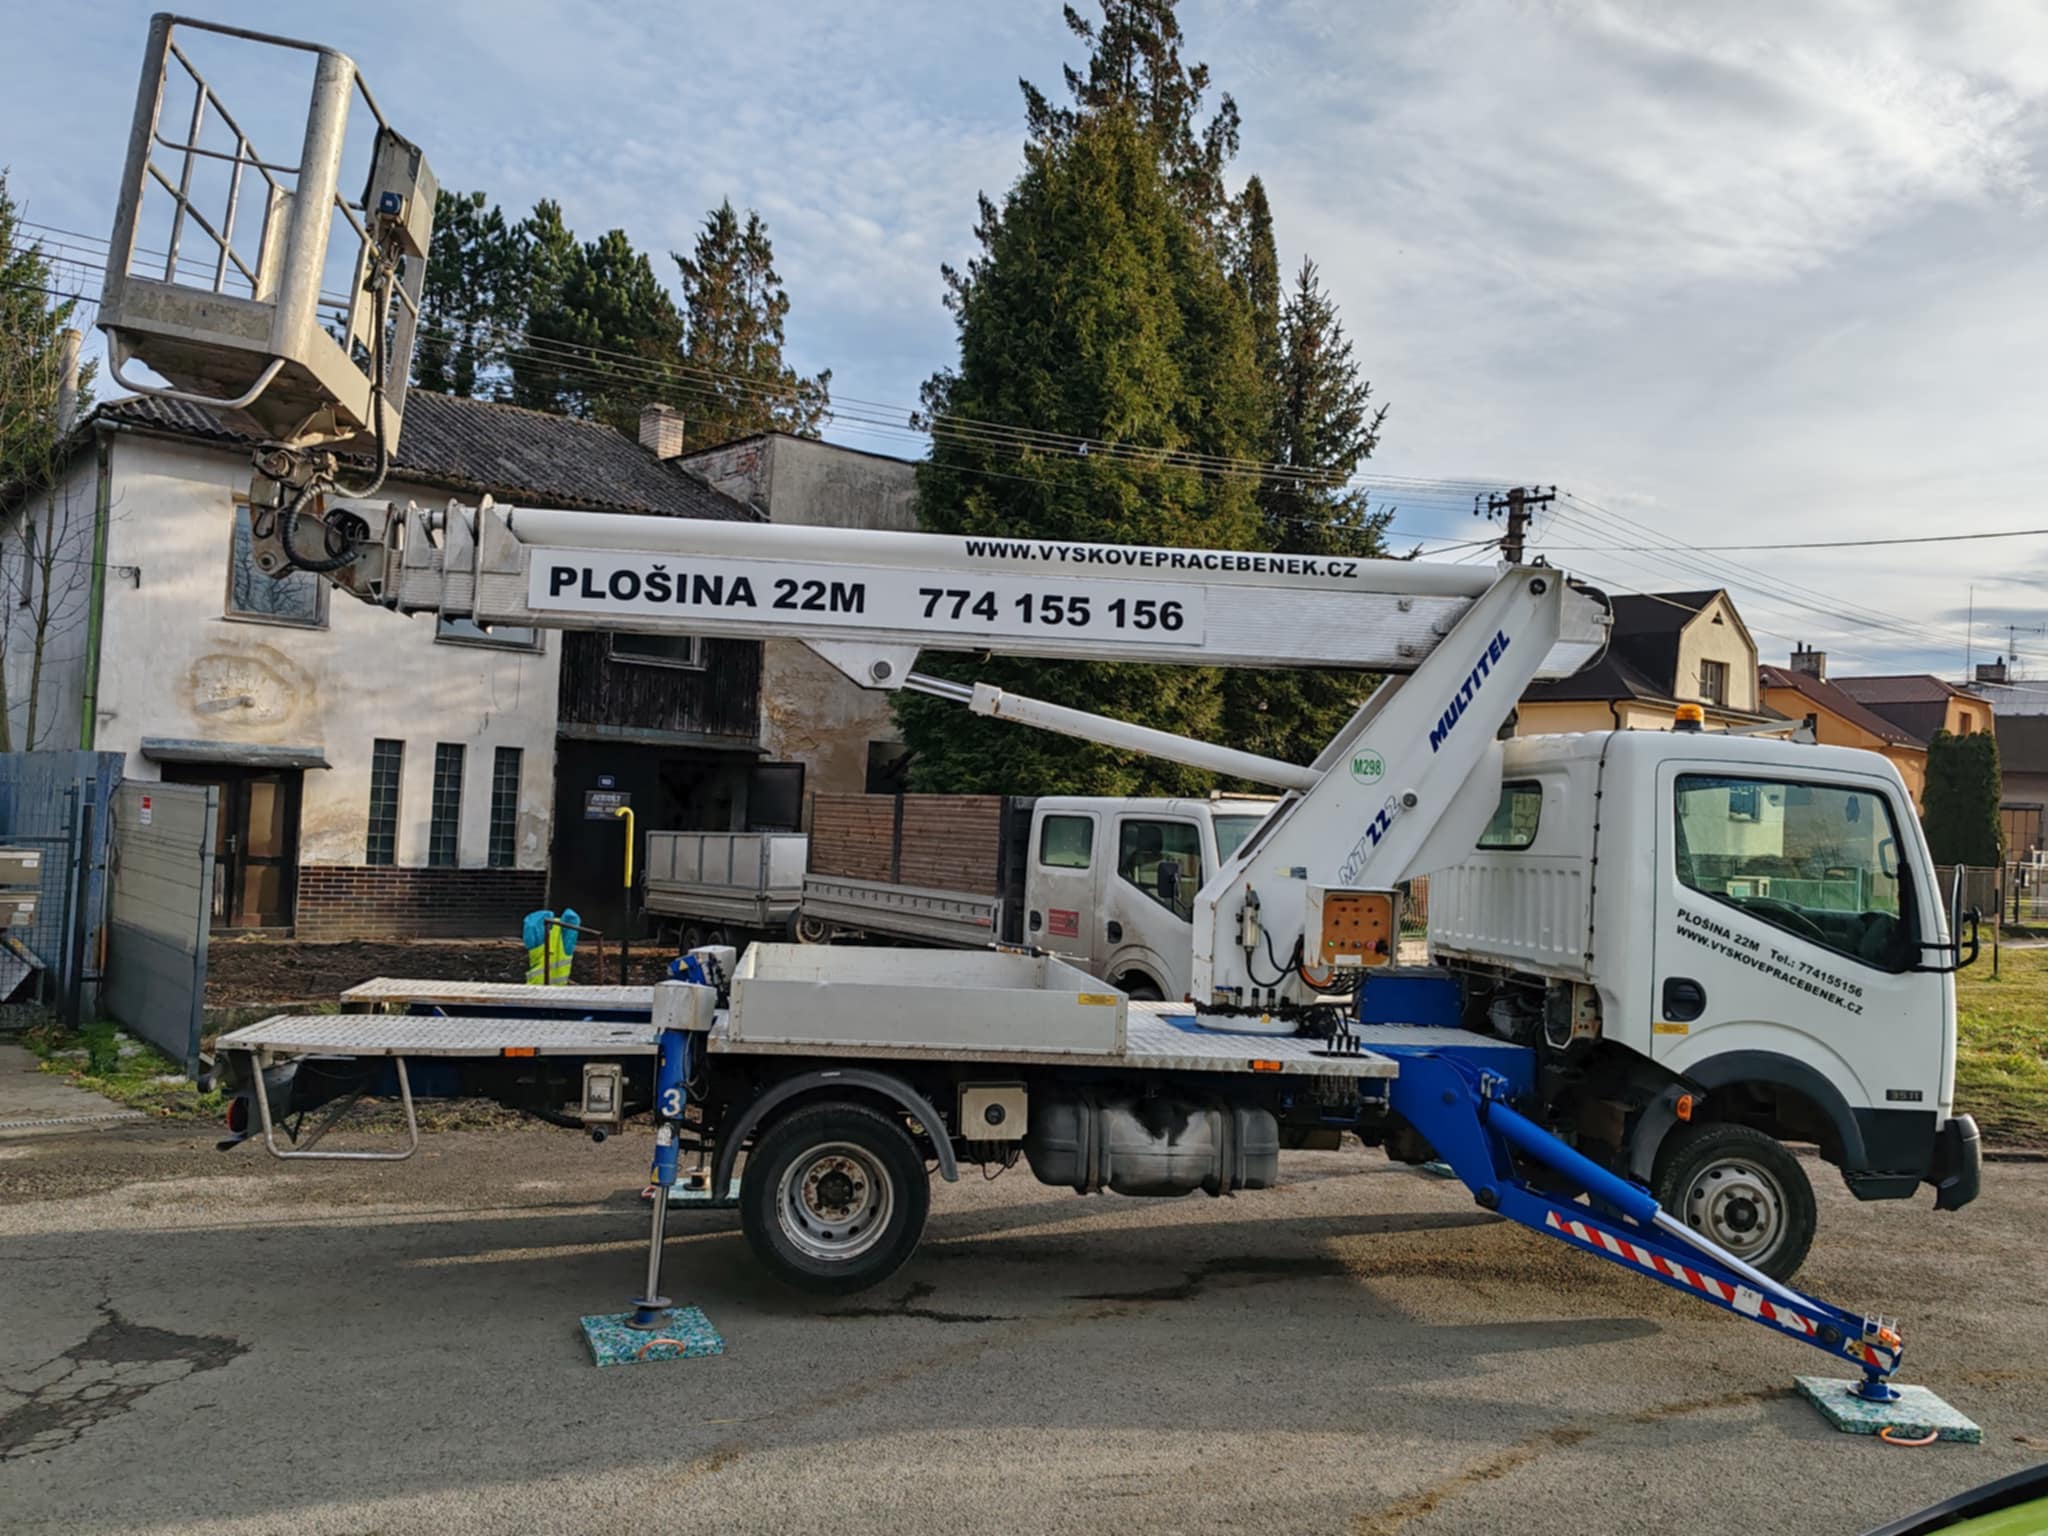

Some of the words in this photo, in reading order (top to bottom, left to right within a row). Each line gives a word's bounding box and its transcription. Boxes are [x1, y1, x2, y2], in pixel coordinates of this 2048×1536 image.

[966, 540, 1358, 578] WWW.VYSKOVEPRACEBENEK.CZ
[548, 564, 757, 609] PLOŠINA
[773, 578, 867, 613] 22M
[919, 587, 999, 622] 774
[1015, 592, 1091, 626] 155
[1107, 598, 1184, 632] 156
[1429, 629, 1511, 754] MULTITEL
[1354, 759, 1382, 776] M298
[1676, 924, 1865, 1016] WWW.VYSKOVEPRACEBENEK.CZ
[1677, 908, 1731, 940] PLOŠINA
[1733, 933, 1761, 952] 22M
[1770, 948, 1796, 969] Tel.:
[1799, 961, 1864, 998] 774155156
[661, 1087, 681, 1117] 3
